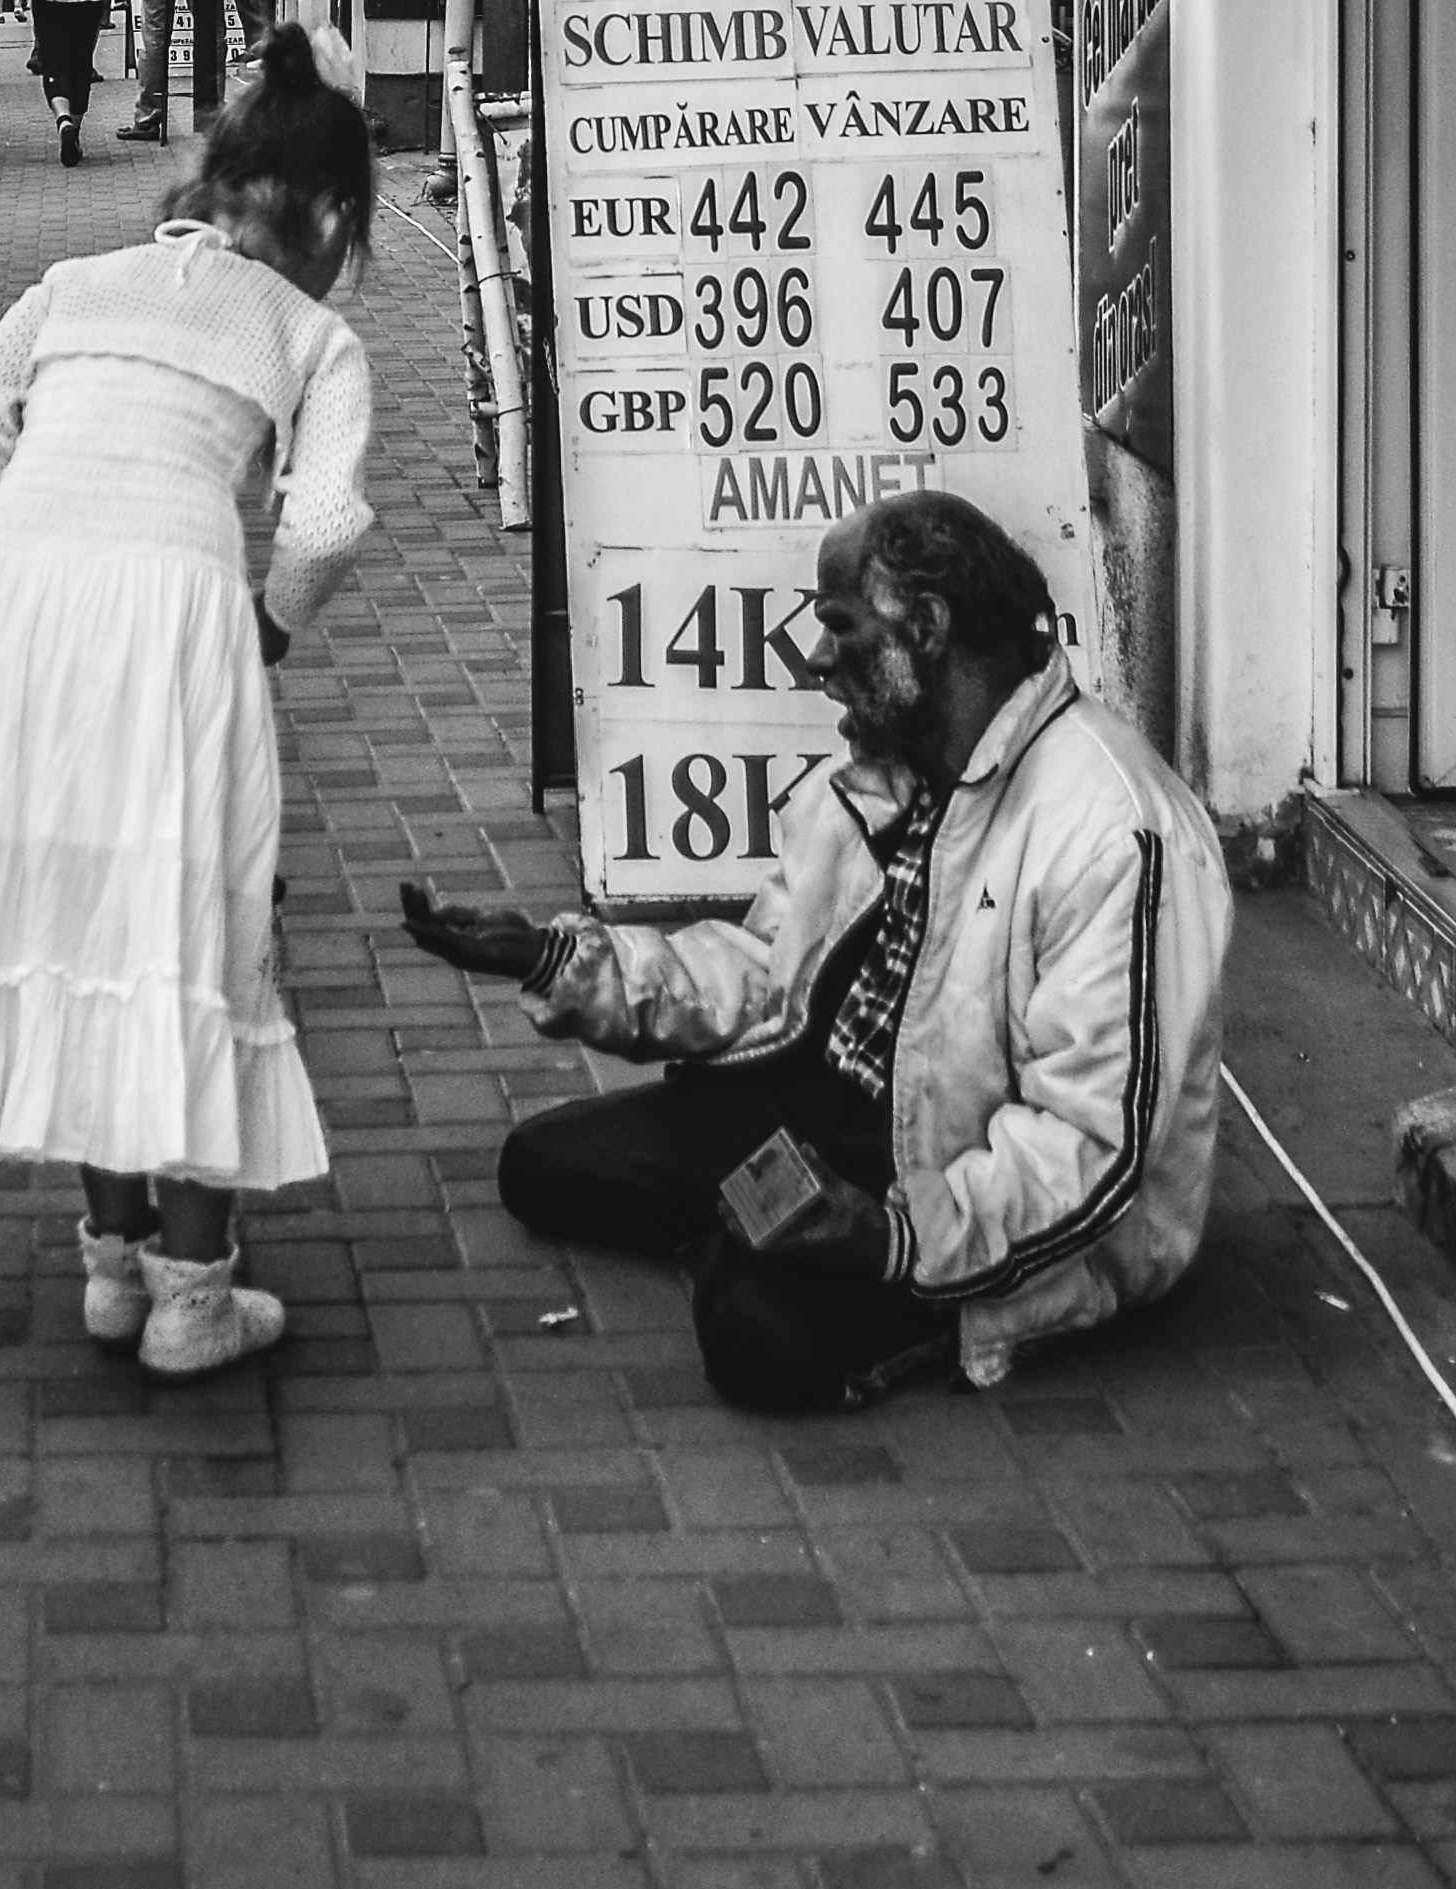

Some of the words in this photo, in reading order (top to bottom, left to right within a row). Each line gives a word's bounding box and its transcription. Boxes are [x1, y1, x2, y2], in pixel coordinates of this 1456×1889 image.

[563, 9, 788, 68] SCHIMB
[796, 0, 1022, 57] VALUTAR
[569, 101, 795, 155] CUMPĂRARE
[805, 91, 1030, 141] VÂNZARE
[570, 197, 677, 239] EUR
[690, 169, 812, 255] 442
[865, 169, 990, 255] 445
[1107, 97, 1141, 254] pret
[574, 292, 685, 338] USD
[693, 265, 814, 350] 396
[882, 265, 1006, 348] 407
[578, 389, 687, 433] GBP
[697, 360, 822, 447] 520
[889, 361, 1010, 444] 533
[606, 582, 824, 691] 14K
[609, 752, 834, 862] 18K
